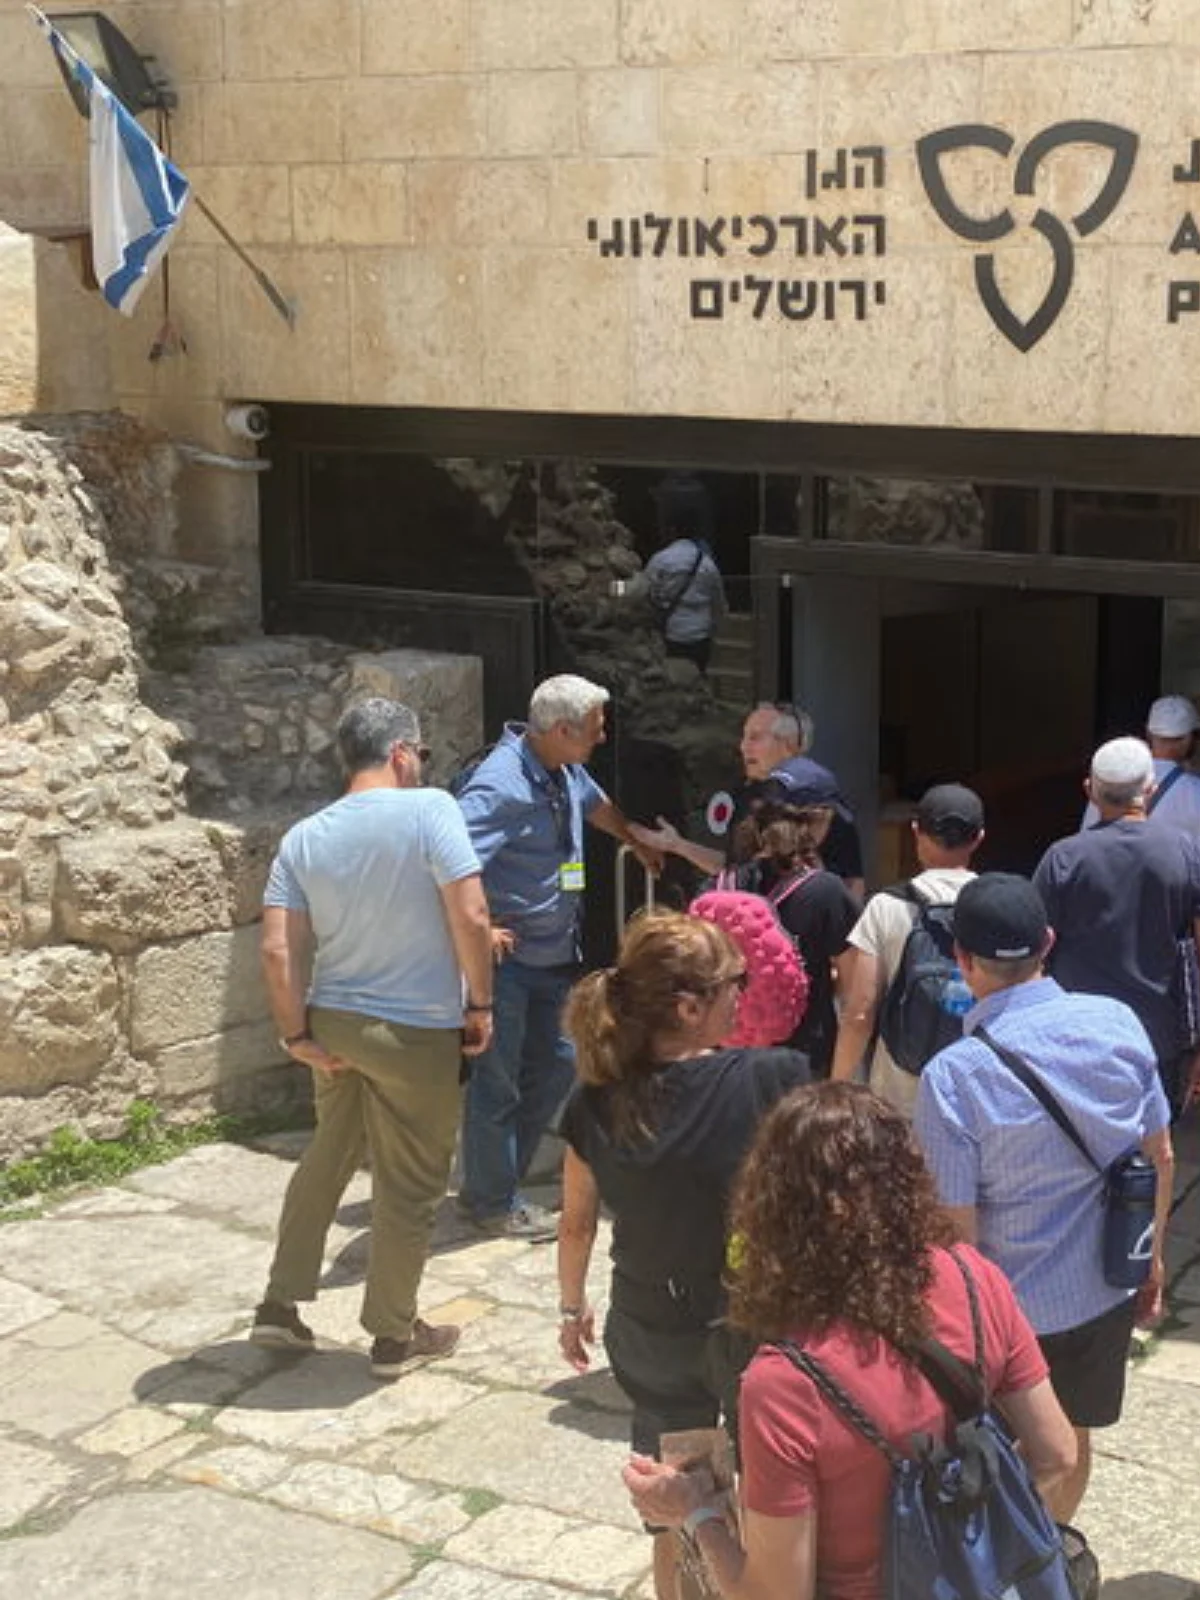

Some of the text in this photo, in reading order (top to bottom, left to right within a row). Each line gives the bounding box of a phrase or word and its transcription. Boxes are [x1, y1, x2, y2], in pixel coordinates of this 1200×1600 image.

[807, 147, 885, 199] הגן
[588, 214, 885, 257] הארכיאולוגי
[691, 275, 885, 320] ירושלים
